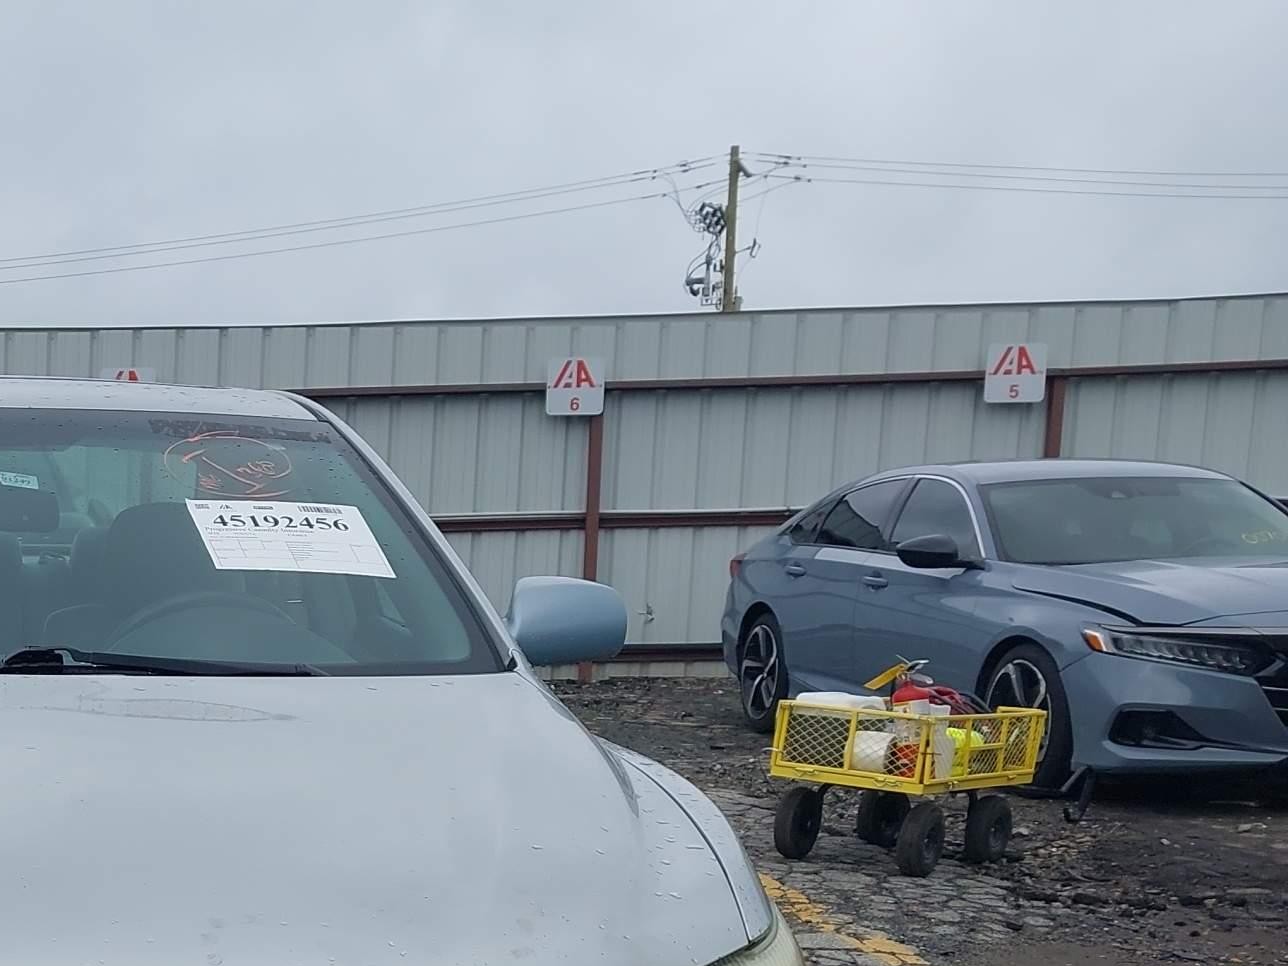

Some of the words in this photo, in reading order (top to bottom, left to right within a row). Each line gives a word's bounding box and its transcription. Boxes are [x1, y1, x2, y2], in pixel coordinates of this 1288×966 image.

[1009, 383, 1019, 399] 5
[570, 397, 580, 411] 6
[212, 514, 350, 532] 45192456
